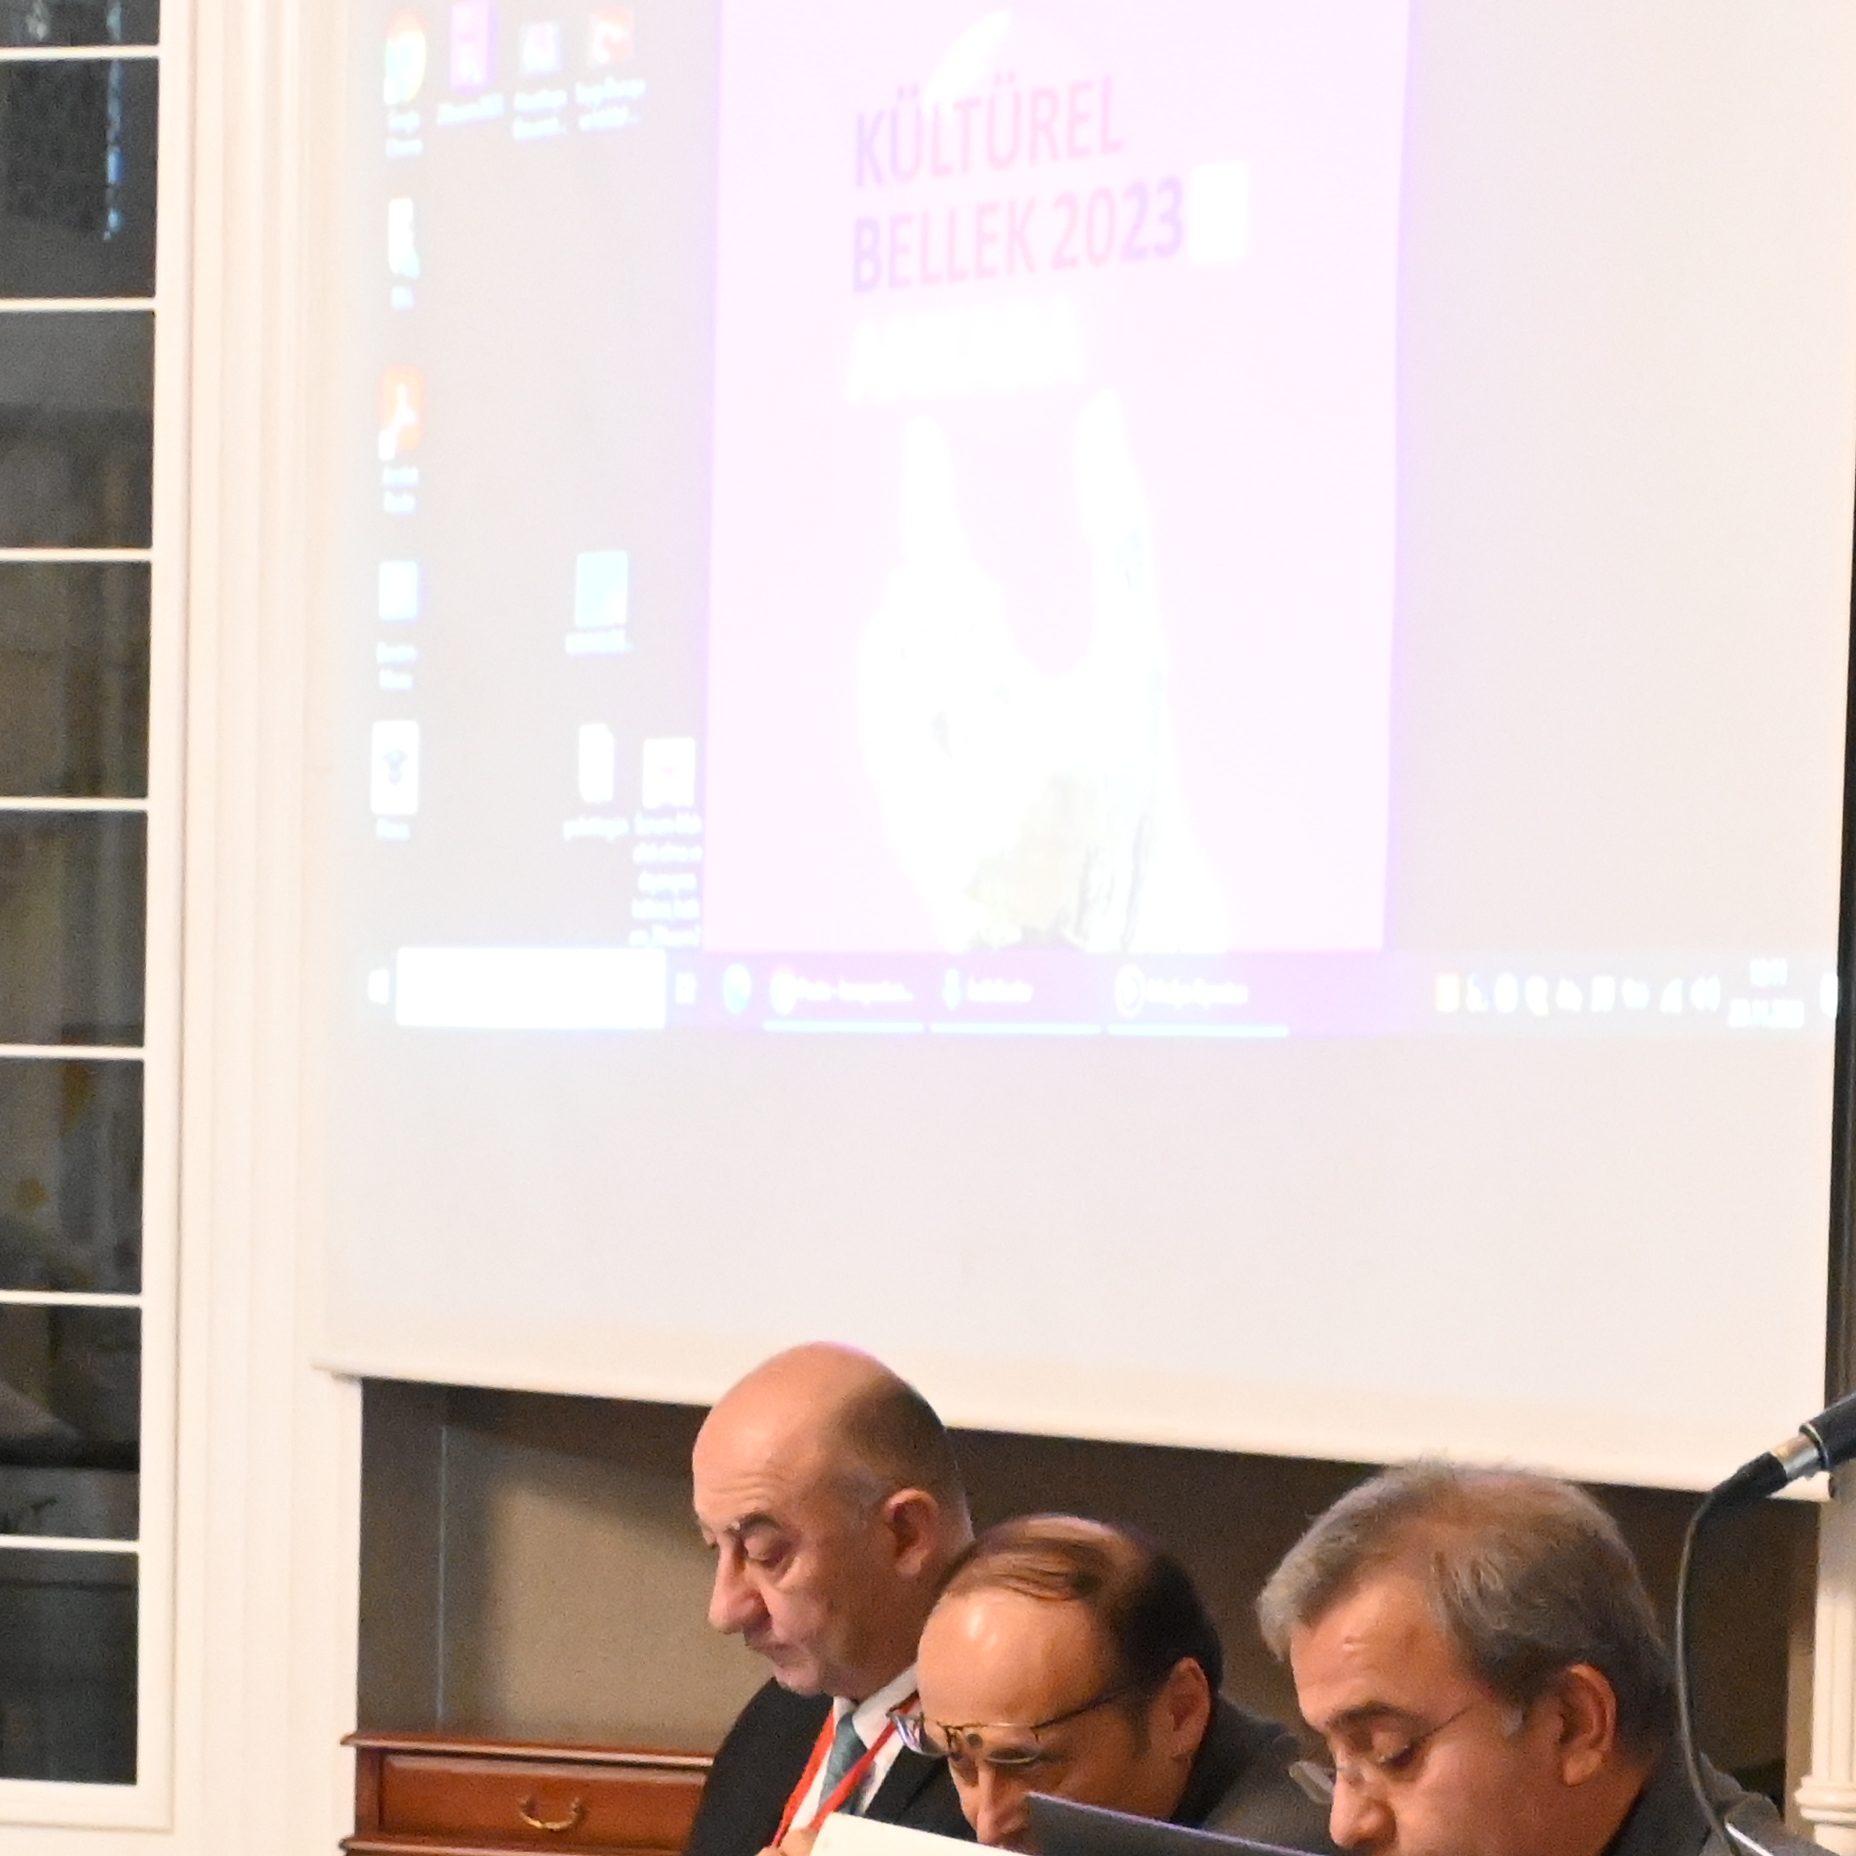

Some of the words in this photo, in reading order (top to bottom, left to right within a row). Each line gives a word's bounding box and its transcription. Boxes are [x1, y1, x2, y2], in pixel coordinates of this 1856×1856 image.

[855, 69, 1124, 188] KÜLTÜREL
[853, 195, 1037, 294] BELLEK
[1049, 176, 1184, 271] 2023
